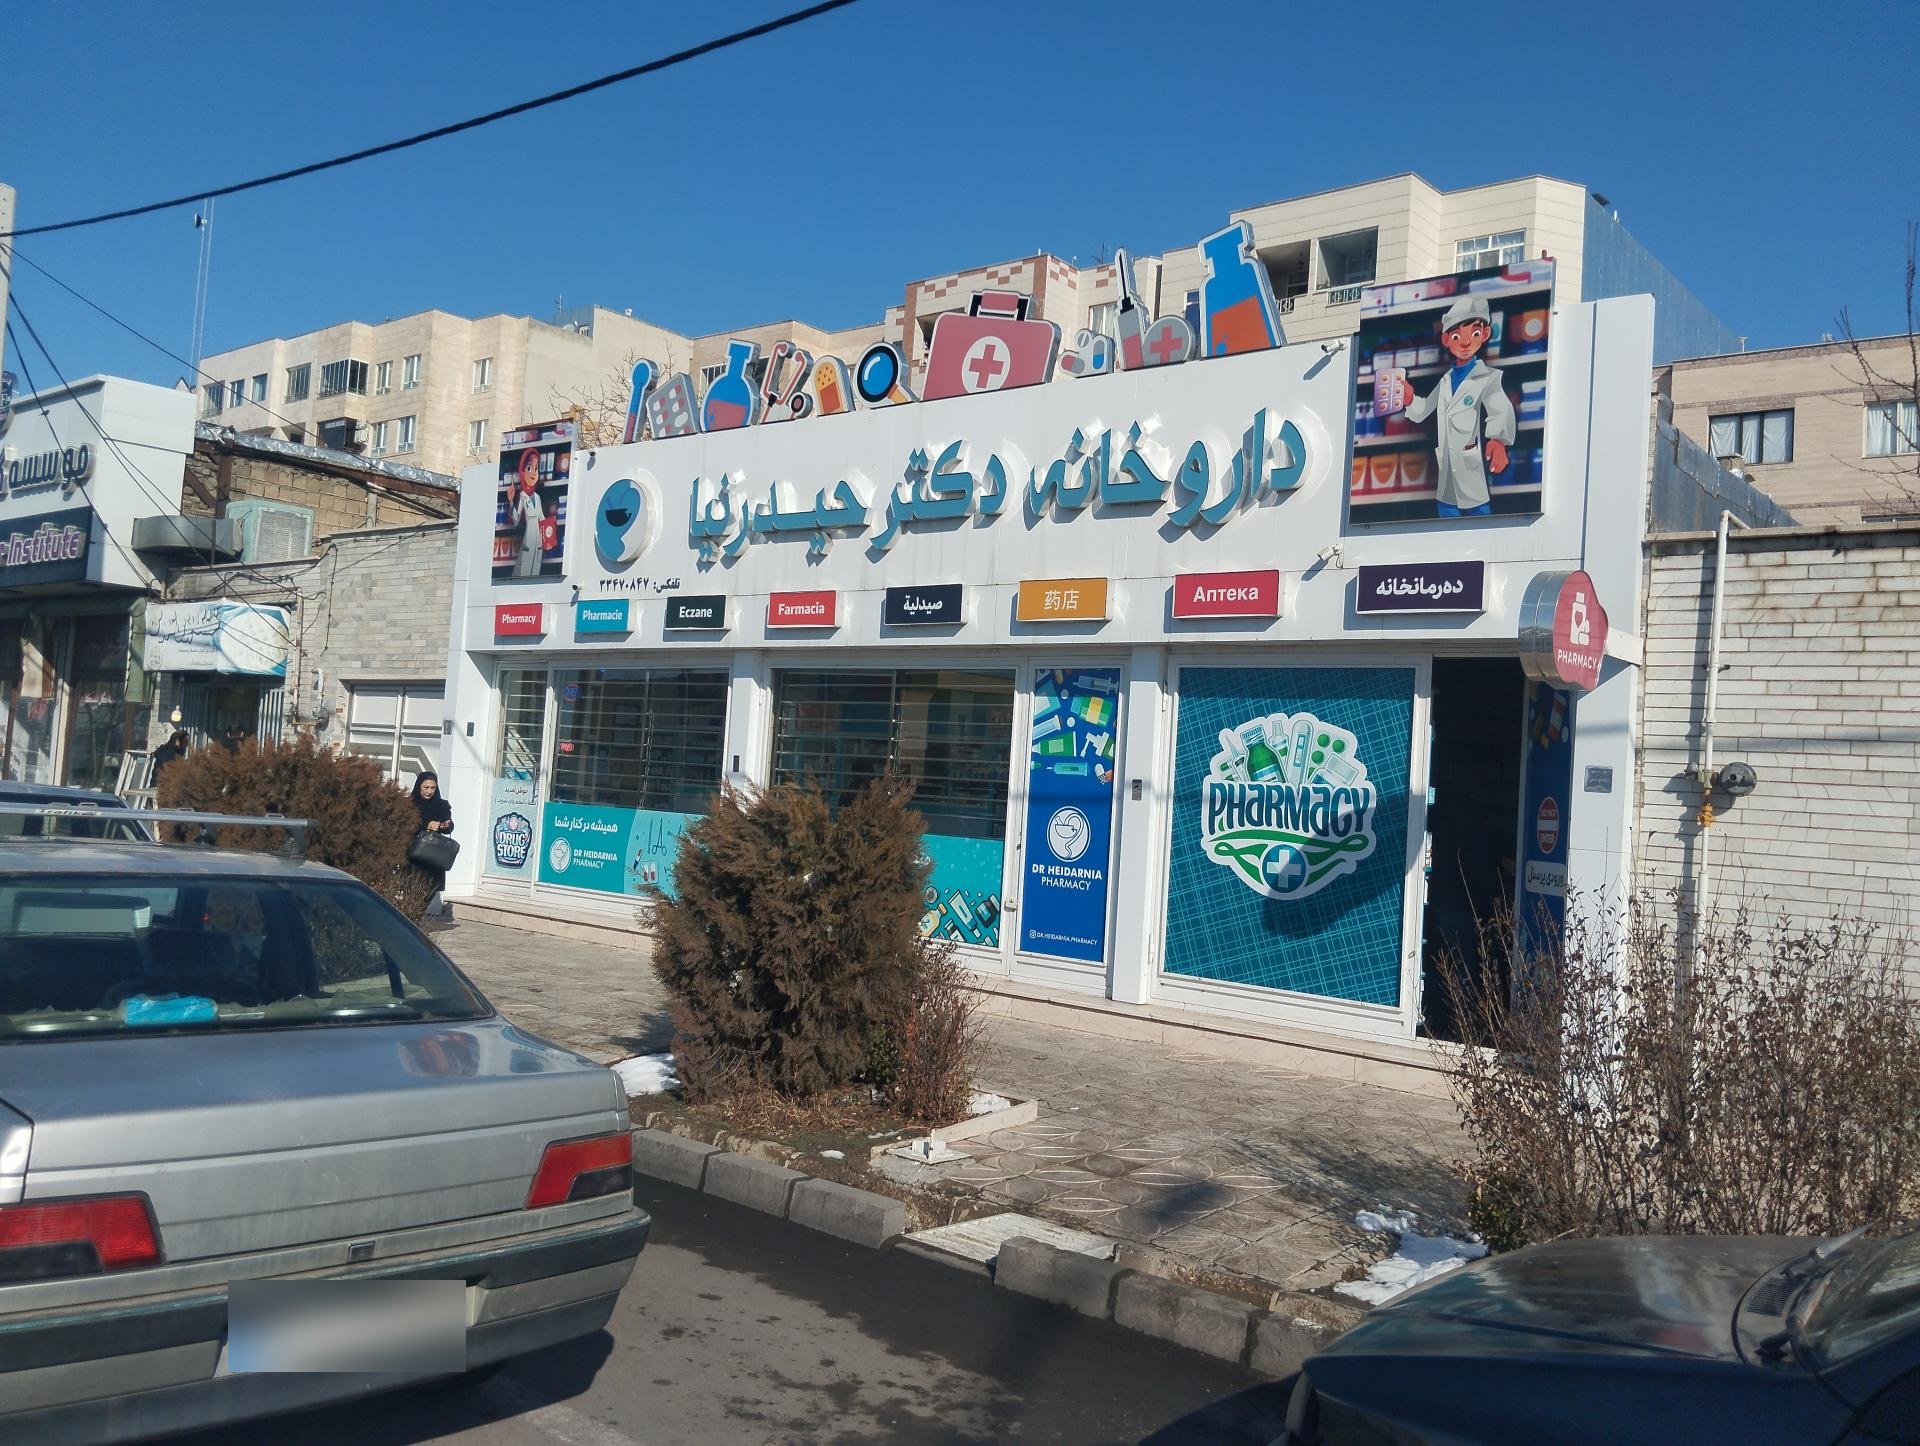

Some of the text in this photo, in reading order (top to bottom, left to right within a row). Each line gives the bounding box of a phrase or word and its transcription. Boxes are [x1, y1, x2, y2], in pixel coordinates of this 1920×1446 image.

[690, 406, 1307, 562] داروخانه دکتر حیدرنیا
[7, 523, 80, 566] Institute
[1044, 588, 1080, 611] 药店
[1193, 585, 1259, 603] Аптека
[582, 609, 623, 621] Pharmacie
[679, 606, 713, 618] Eczane
[778, 602, 825, 616] Farmacia
[502, 613, 537, 625] Pharmacy
[1557, 649, 1598, 669] PHARMACY
[554, 815, 618, 834] همیشه در کنار شما
[500, 831, 526, 846] DRUG
[1540, 833, 1555, 844] ENTER
[497, 844, 526, 860] STORE
[573, 849, 618, 861] DR HEIDARNIA
[573, 859, 605, 869] PHARMACY
[1032, 863, 1103, 880] DR HEIDARNIA
[1041, 876, 1091, 891] PHARMACY
